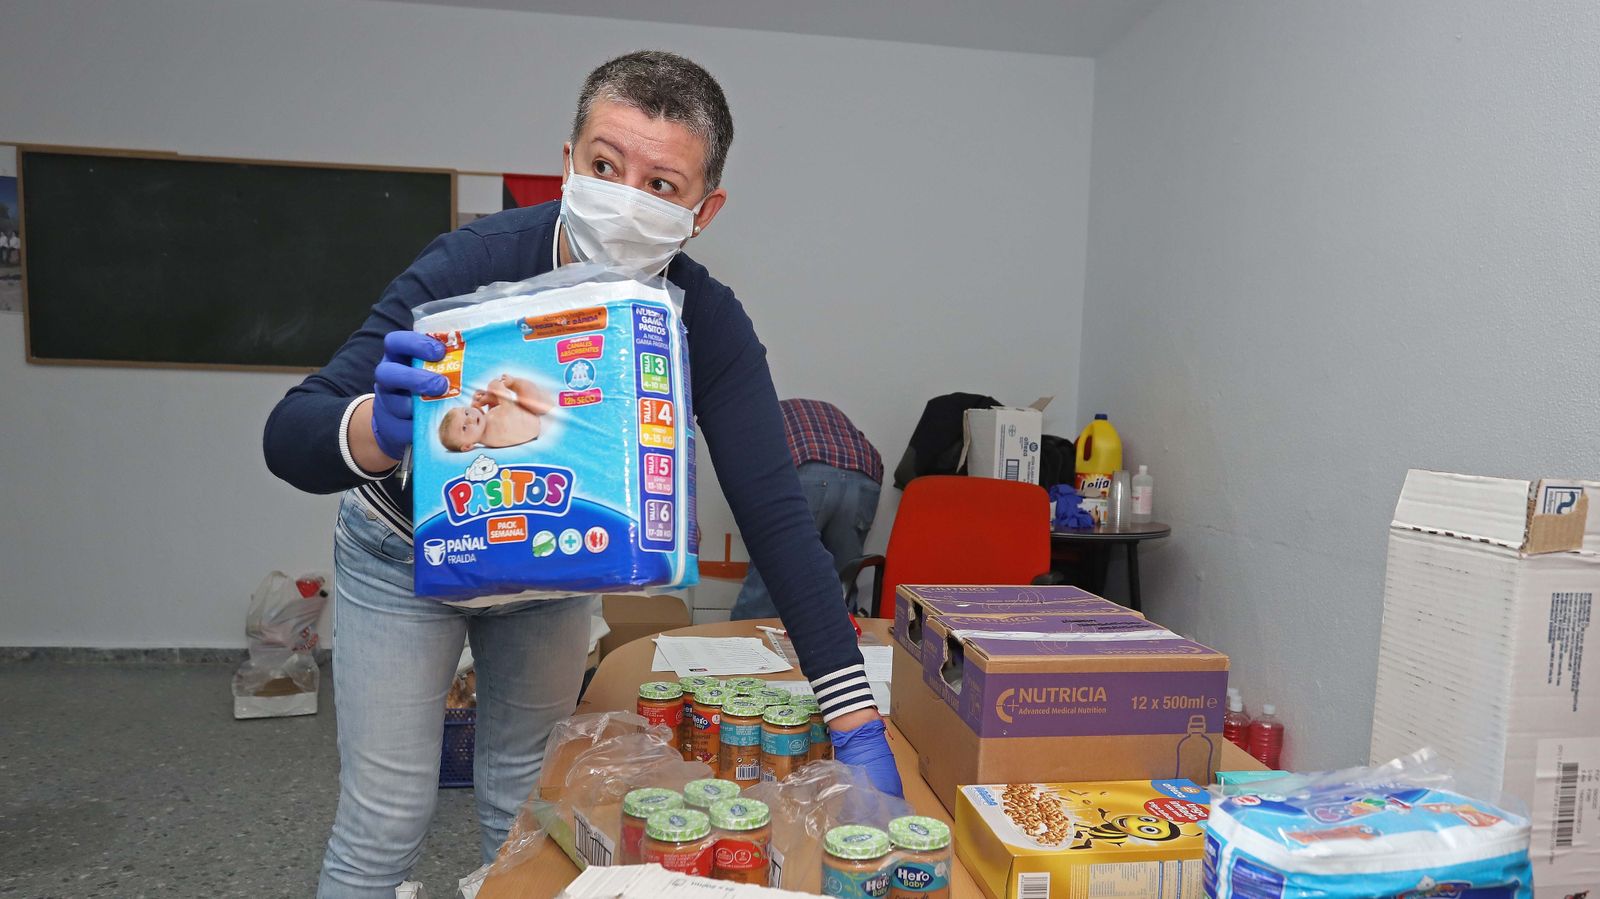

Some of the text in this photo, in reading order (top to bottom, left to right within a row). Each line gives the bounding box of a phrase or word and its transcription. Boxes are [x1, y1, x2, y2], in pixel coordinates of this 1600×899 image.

[639, 323, 666, 336] PASITOS
[655, 357, 665, 375] 3
[643, 400, 652, 424] TALLA
[657, 403, 673, 426] 4
[658, 457, 669, 476] 5
[659, 503, 670, 522] 6
[497, 520, 517, 530] PACK
[490, 527, 525, 539] SEMANAL
[447, 534, 487, 553] PAÑAL
[447, 553, 477, 565] FRALDA
[1018, 686, 1107, 704] NUTRICIA
[1131, 696, 1148, 710] 12
[1151, 698, 1159, 710] x
[1163, 695, 1204, 710] 500ml
[1018, 705, 1107, 716] Advanced Medical Nutrition
[897, 868, 930, 882] Hero
[903, 879, 925, 889] Baby
